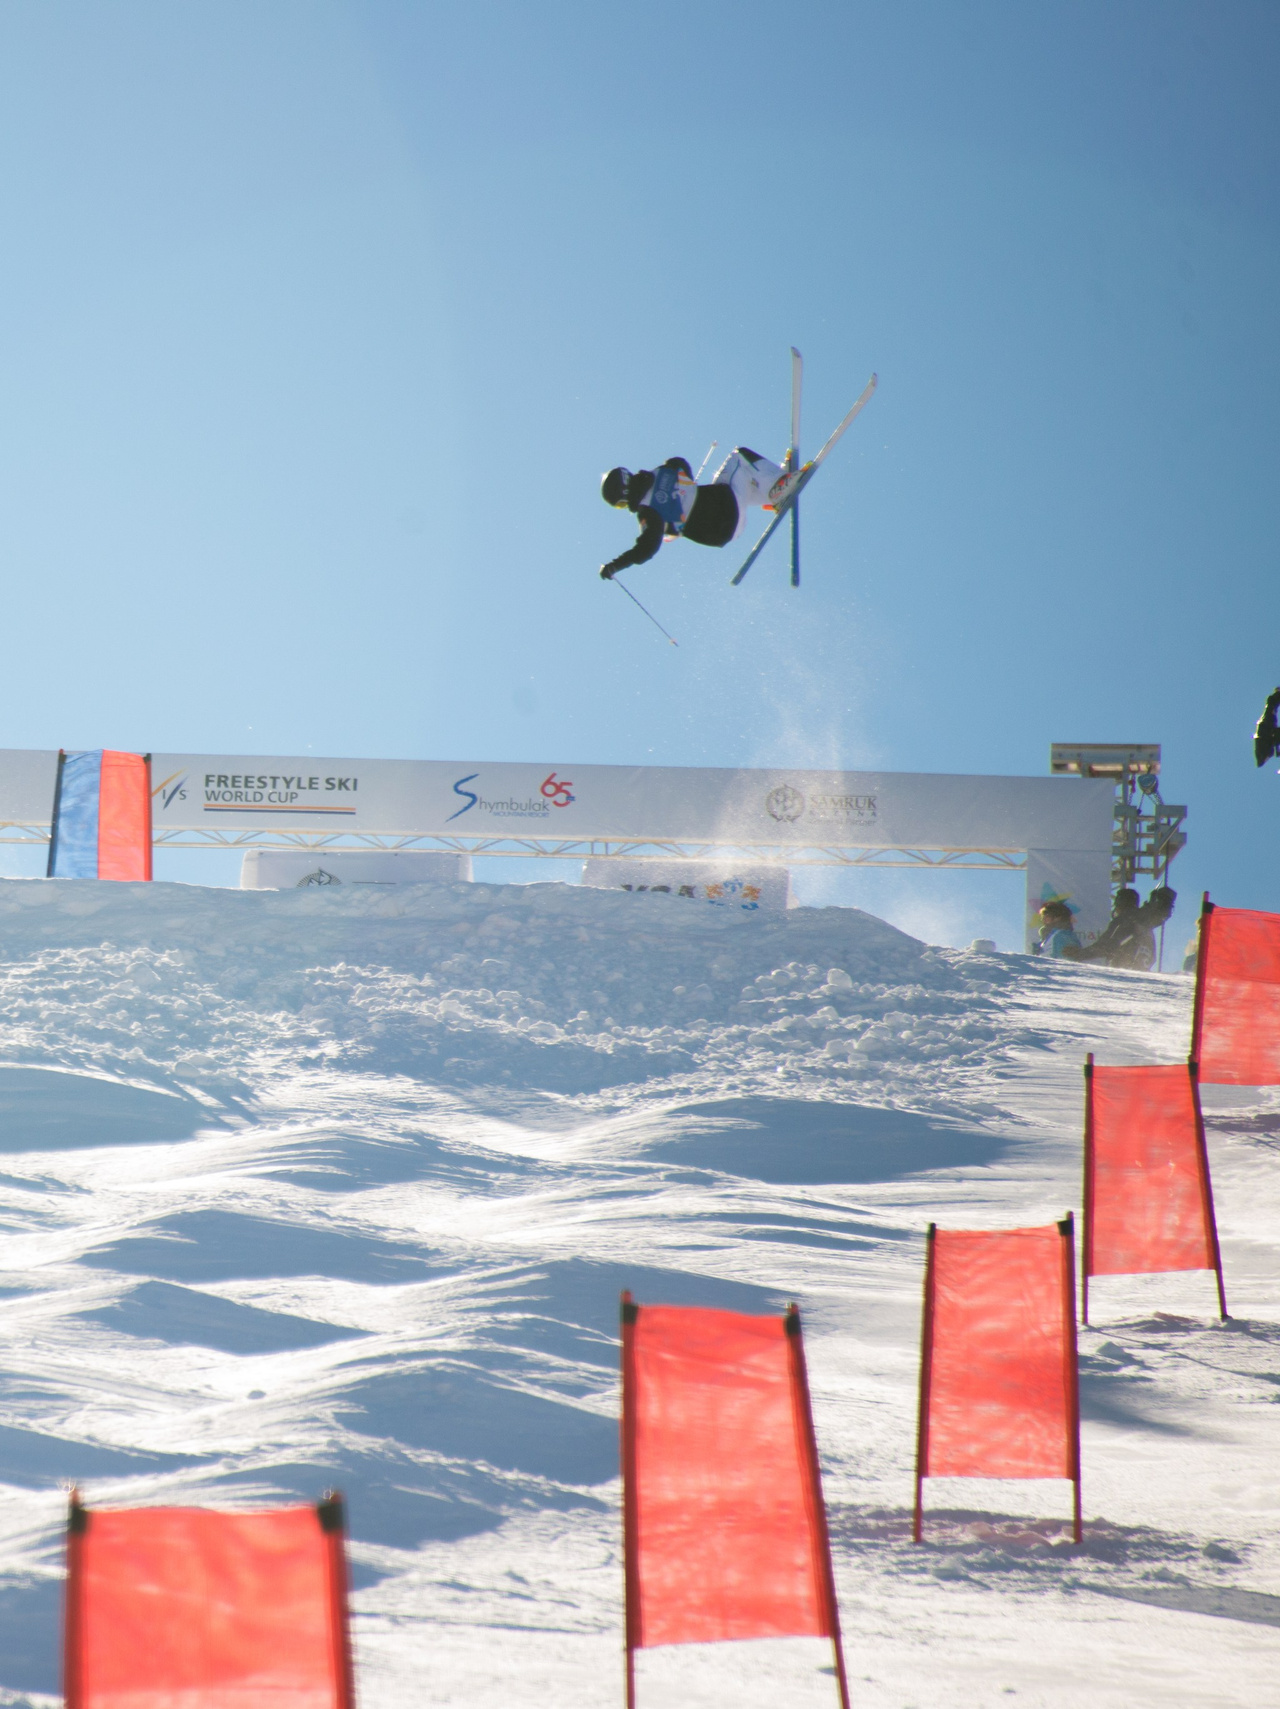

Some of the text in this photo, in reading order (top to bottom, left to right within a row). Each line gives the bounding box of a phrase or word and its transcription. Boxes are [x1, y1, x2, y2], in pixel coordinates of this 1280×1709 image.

[204, 774, 359, 791] FREESTYLE SKI
[540, 772, 574, 808] 65
[204, 790, 299, 804] WORLD CUP
